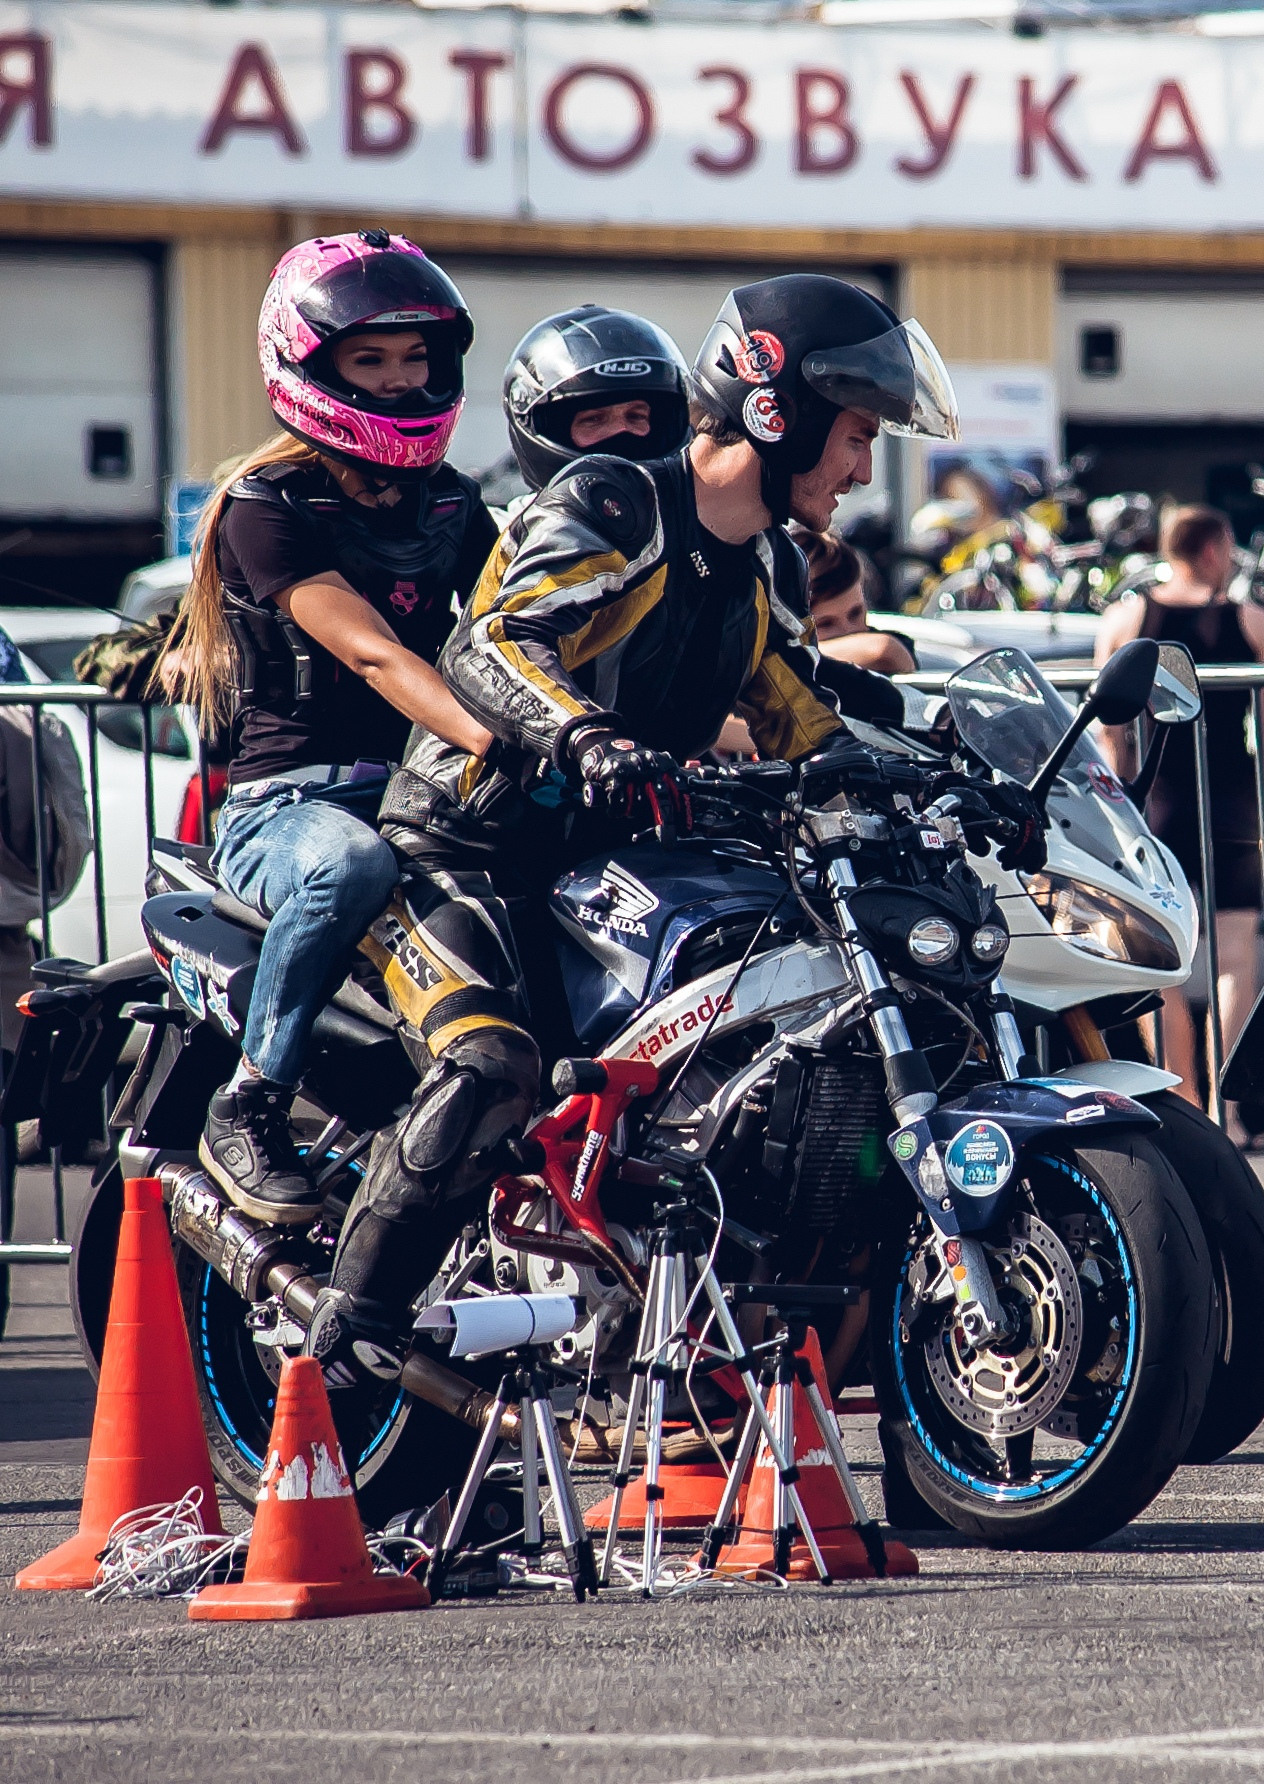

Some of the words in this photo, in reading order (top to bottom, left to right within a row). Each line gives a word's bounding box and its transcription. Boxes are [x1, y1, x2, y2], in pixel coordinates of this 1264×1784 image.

[202, 40, 1219, 184] АВТОЗВУКА
[603, 362, 644, 373] HJC
[629, 994, 735, 1061] tatrade
